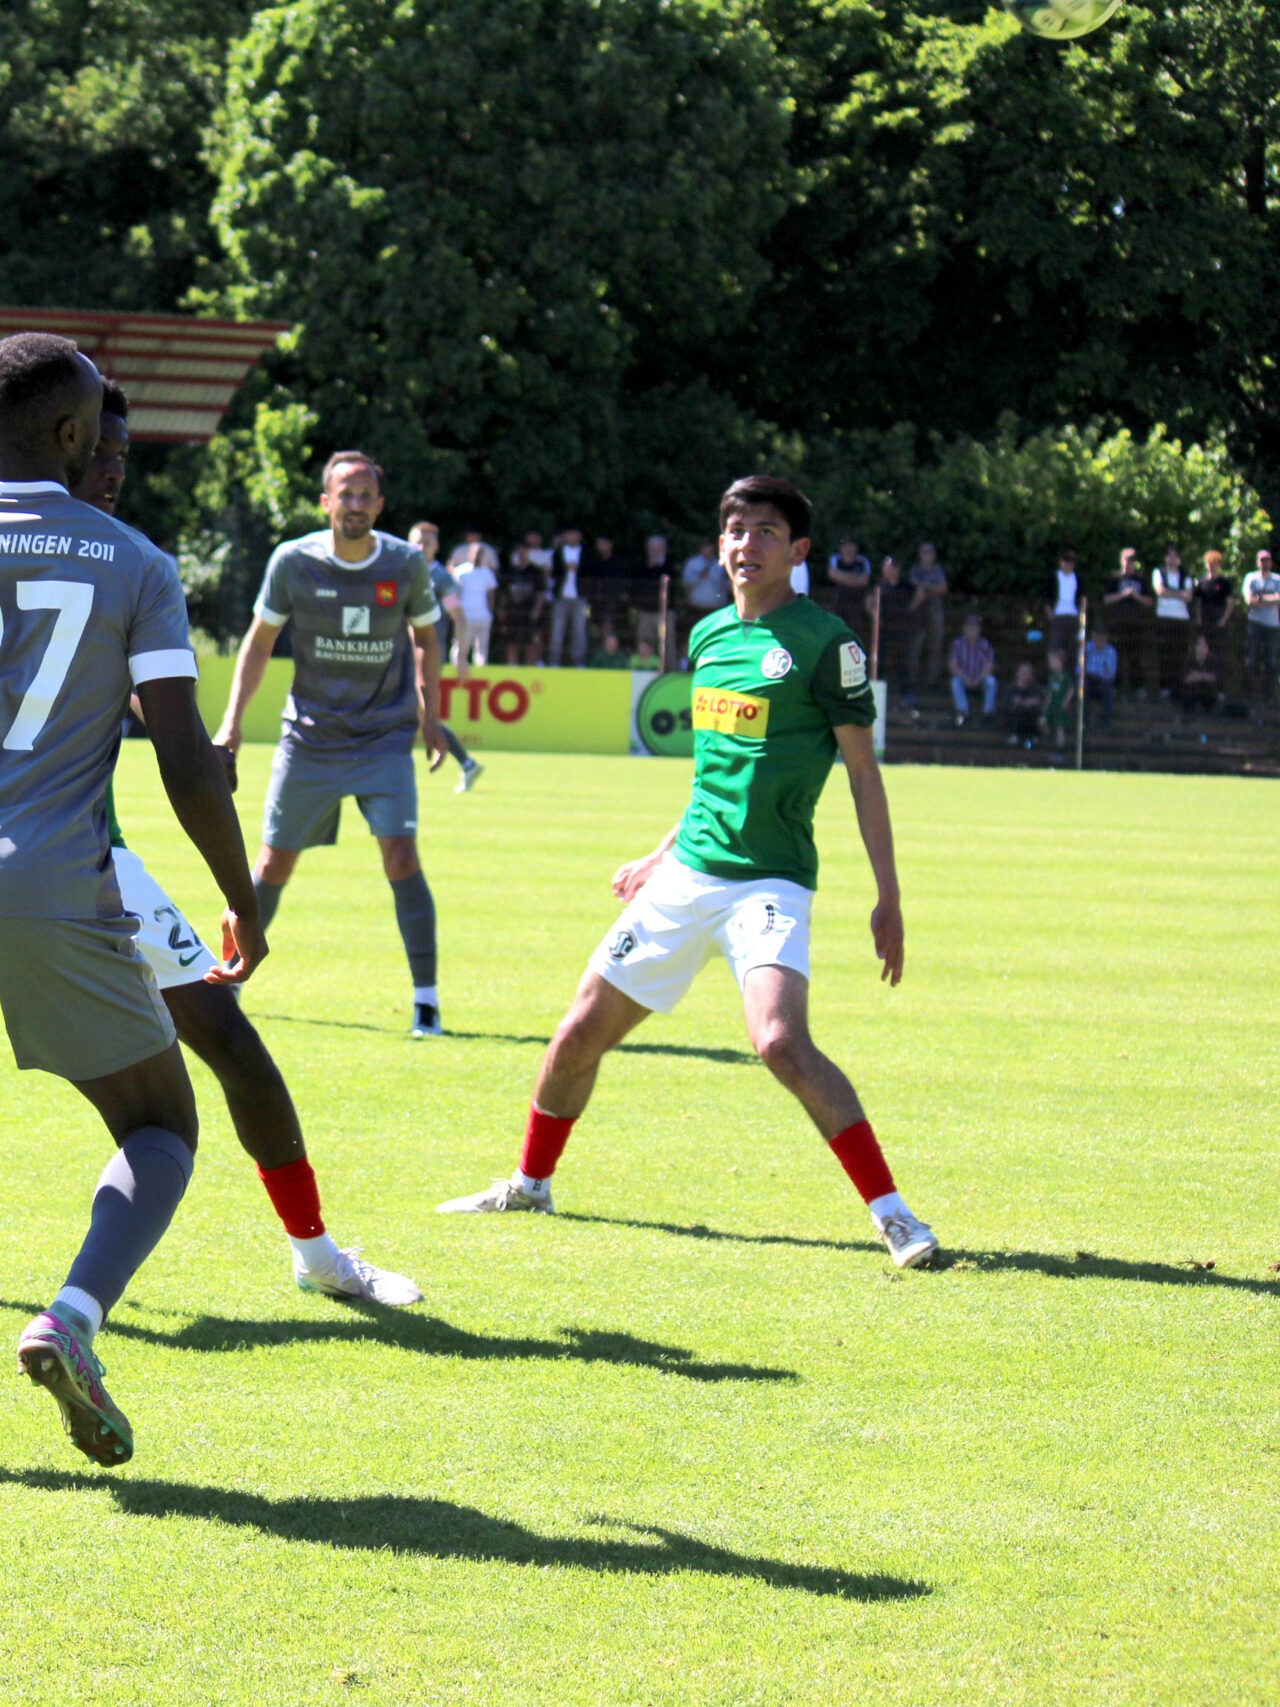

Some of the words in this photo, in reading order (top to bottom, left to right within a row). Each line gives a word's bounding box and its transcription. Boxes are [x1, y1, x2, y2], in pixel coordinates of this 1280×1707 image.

[77, 539, 115, 562] 2011
[437, 678, 530, 723] TTO
[710, 696, 759, 720] LOTTO
